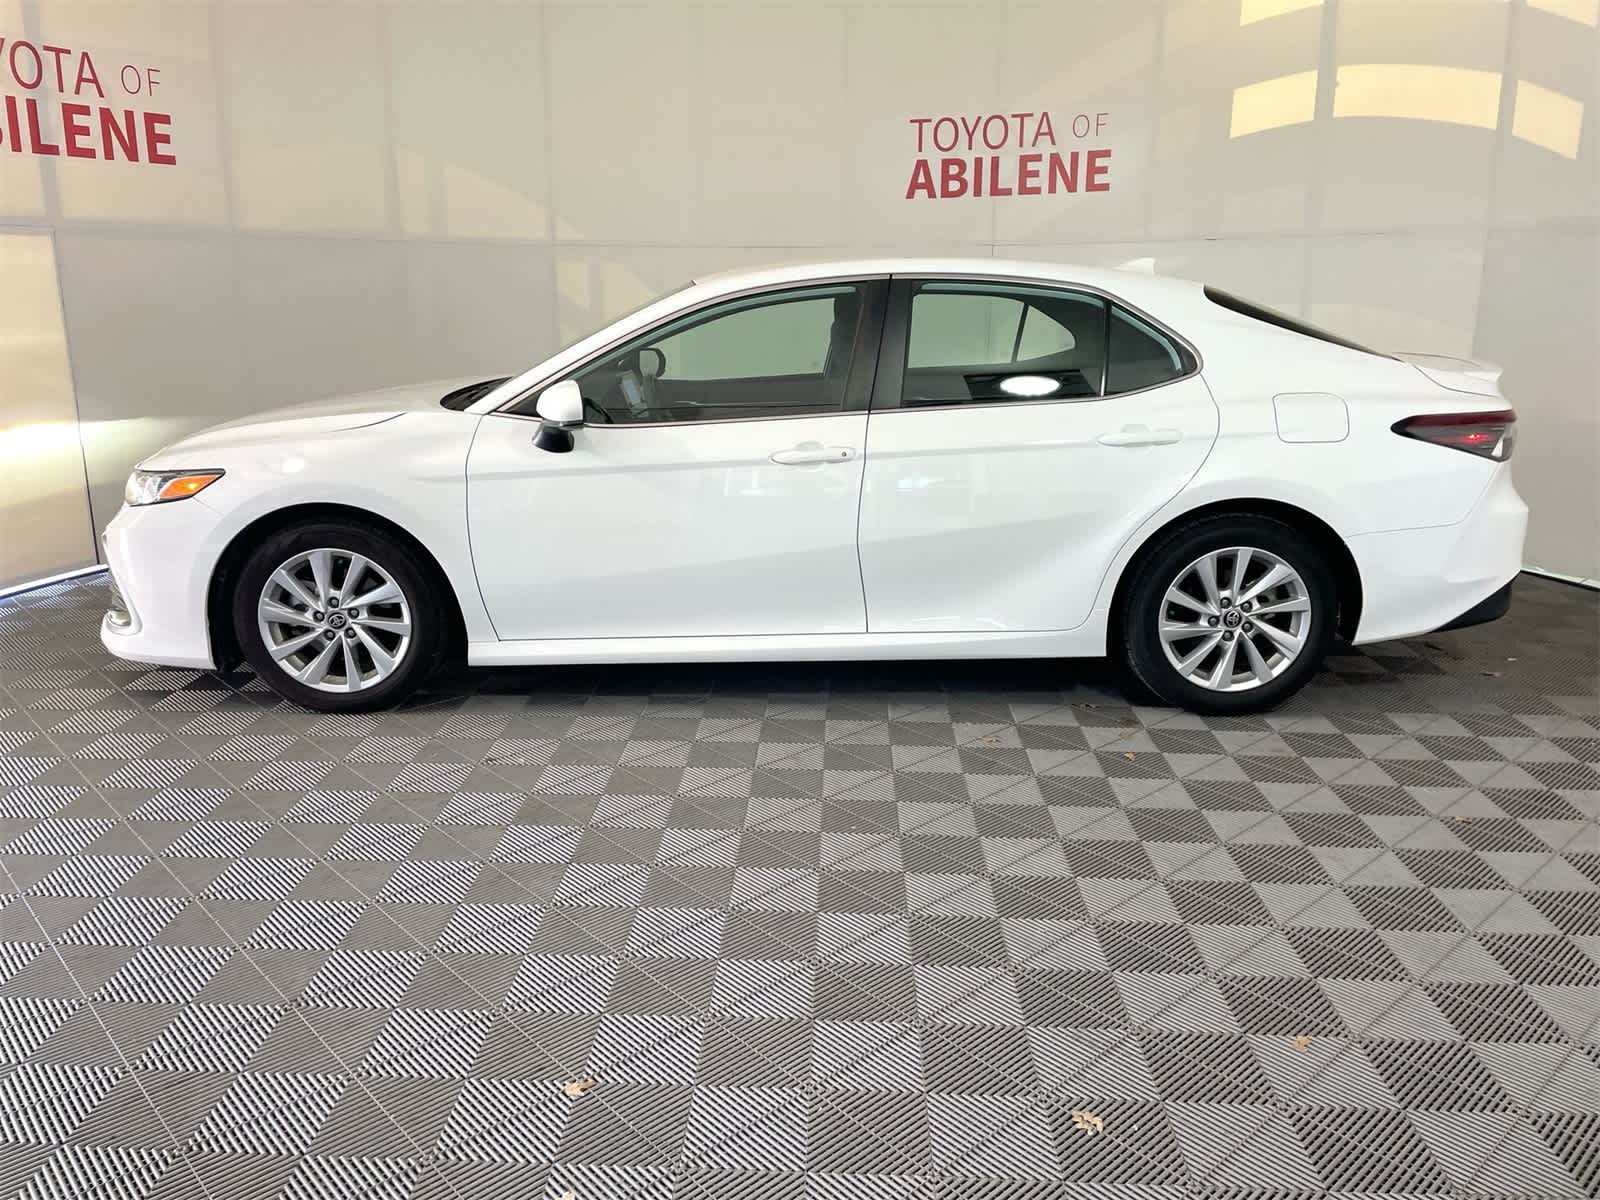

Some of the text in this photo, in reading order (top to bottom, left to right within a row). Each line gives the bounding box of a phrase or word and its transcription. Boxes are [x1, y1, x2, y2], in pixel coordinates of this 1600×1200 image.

[0, 37, 161, 98] OTA OF
[0, 95, 176, 165] ILENE
[909, 112, 1109, 152] TOYOTA OF
[905, 149, 1112, 200] ABILENE
